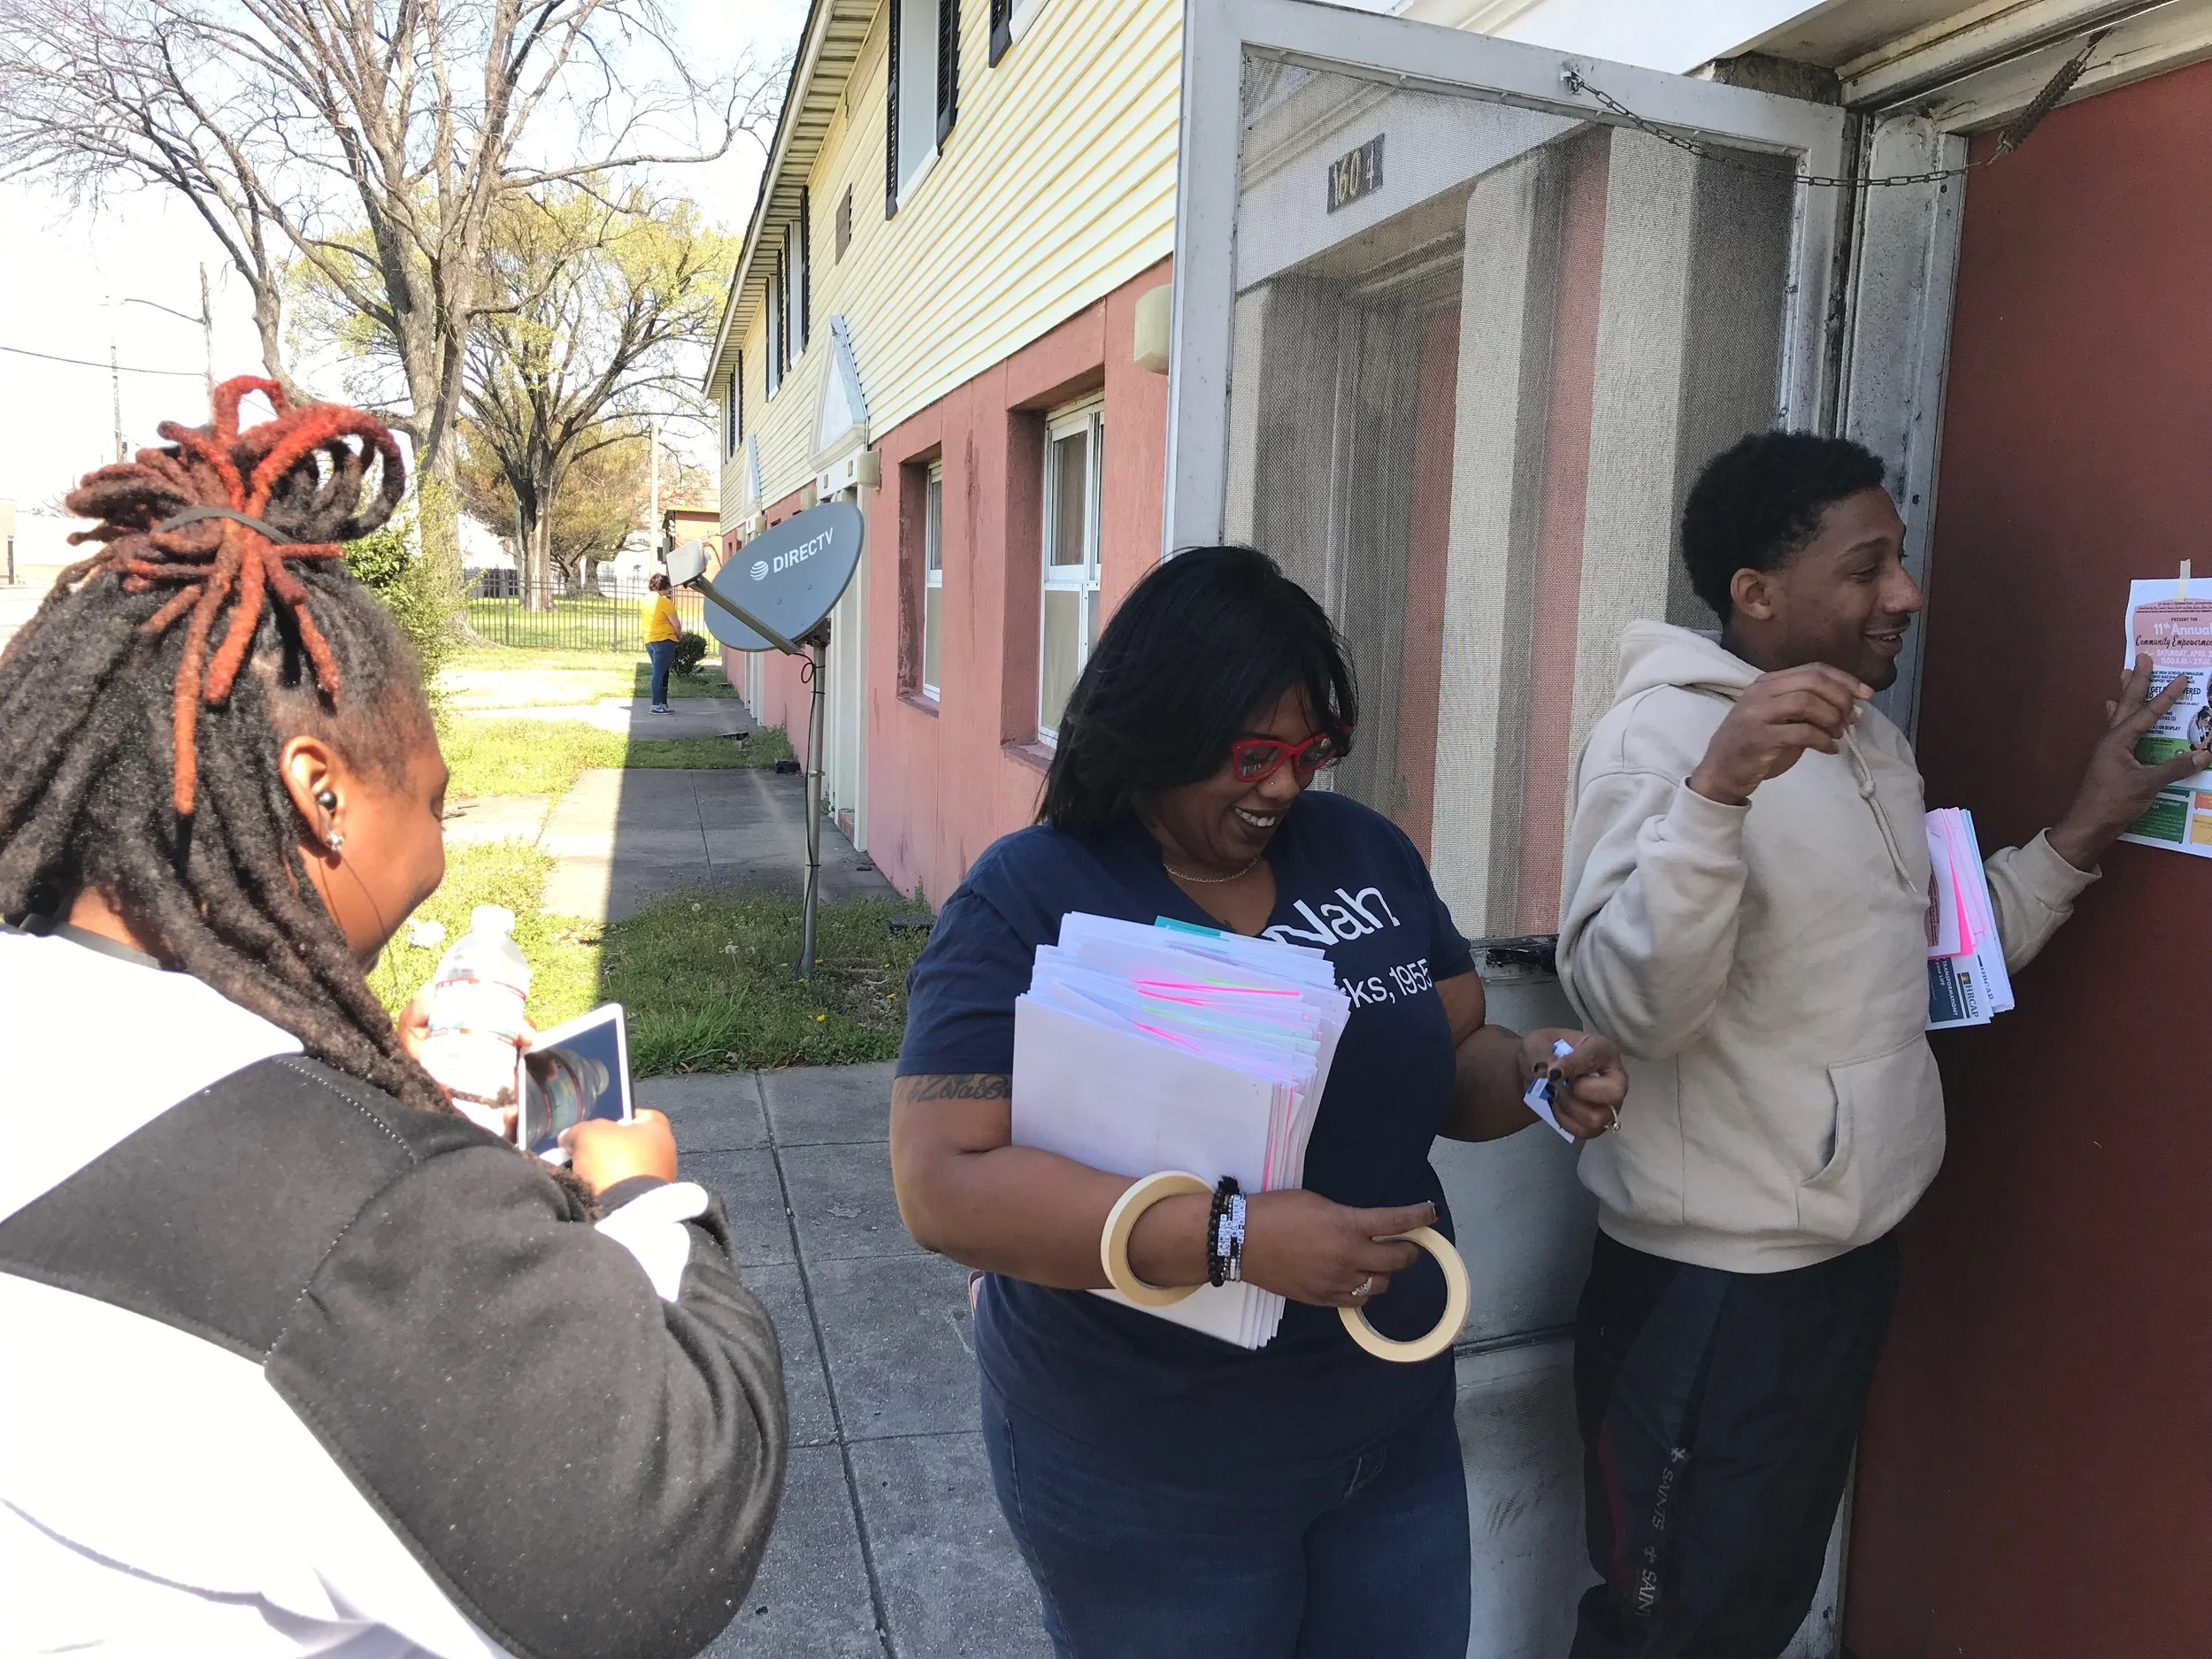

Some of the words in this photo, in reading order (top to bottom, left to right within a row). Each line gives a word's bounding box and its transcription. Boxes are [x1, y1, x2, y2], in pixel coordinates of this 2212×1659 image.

[772, 526, 833, 574] DIRECTV
[2135, 634, 2170, 649] Community
[1389, 957, 1433, 996] 1955
[1965, 984, 1979, 1018] HRCAP
[1652, 1467, 1674, 1532] SAINTS
